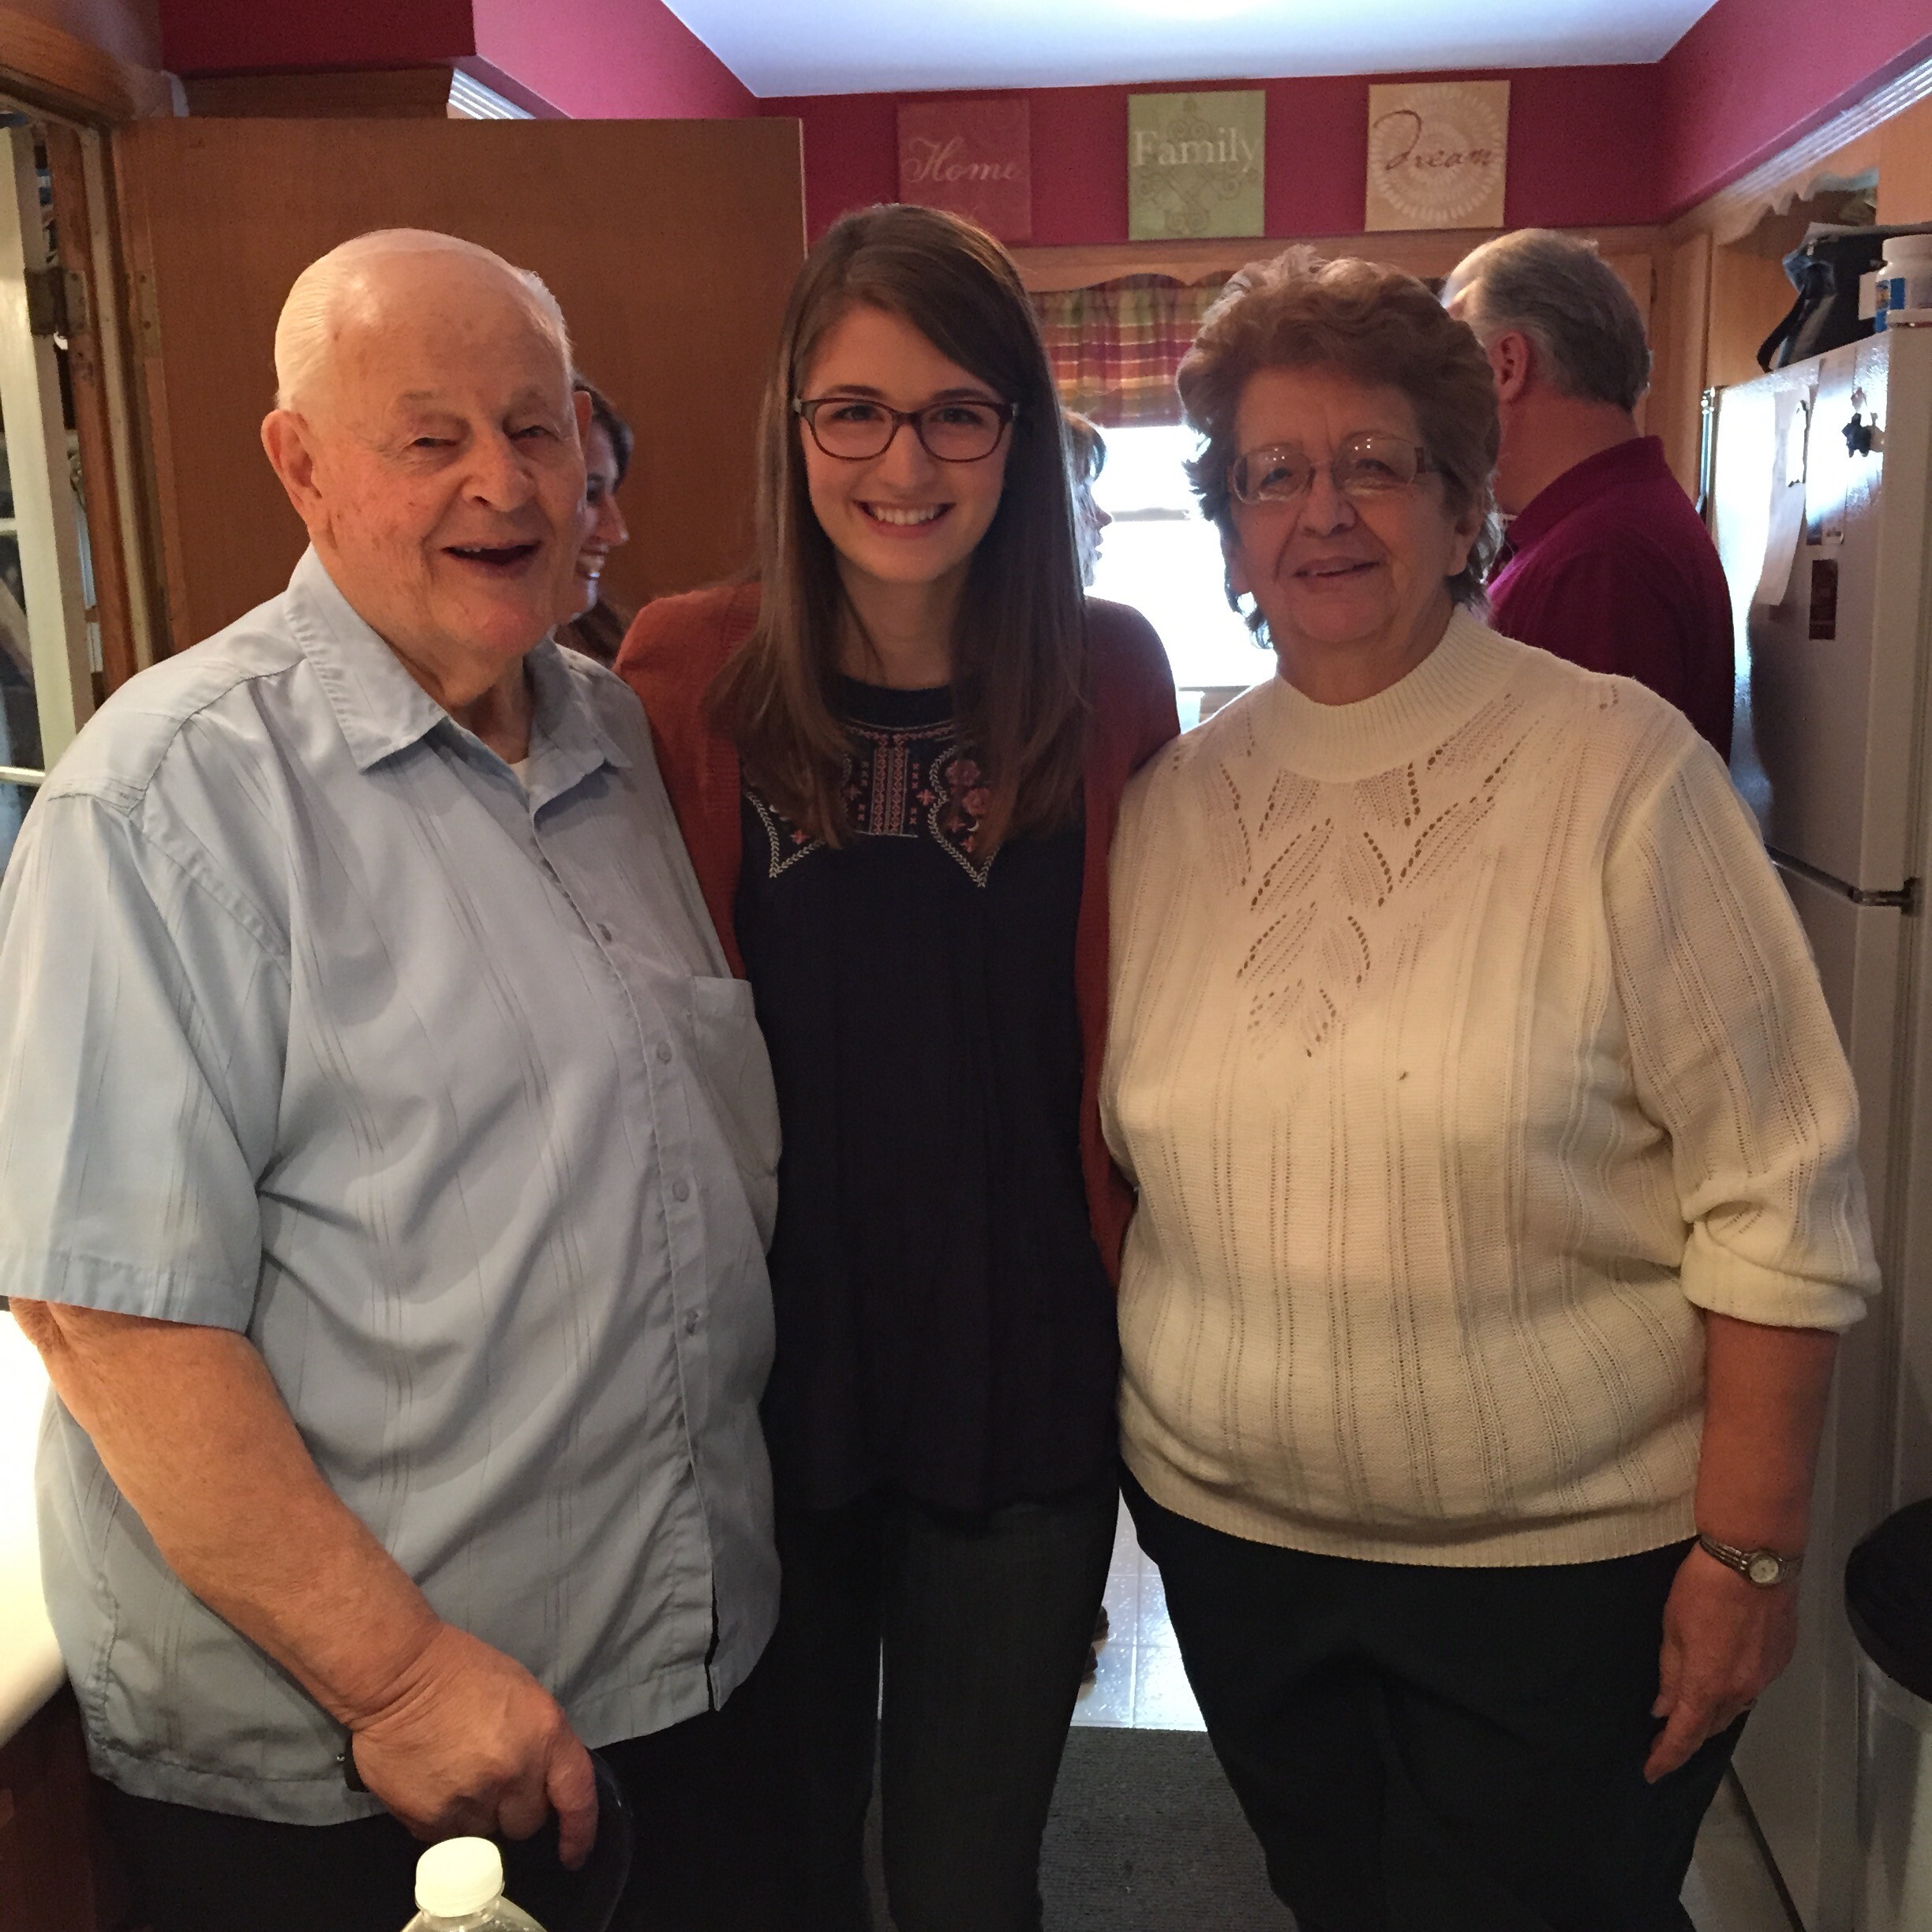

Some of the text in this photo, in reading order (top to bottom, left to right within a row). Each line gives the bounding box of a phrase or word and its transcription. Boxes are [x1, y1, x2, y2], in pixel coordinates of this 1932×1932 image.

[901, 136, 1020, 183] Home
[1133, 127, 1262, 178] Family
[1372, 109, 1492, 170] Dream
